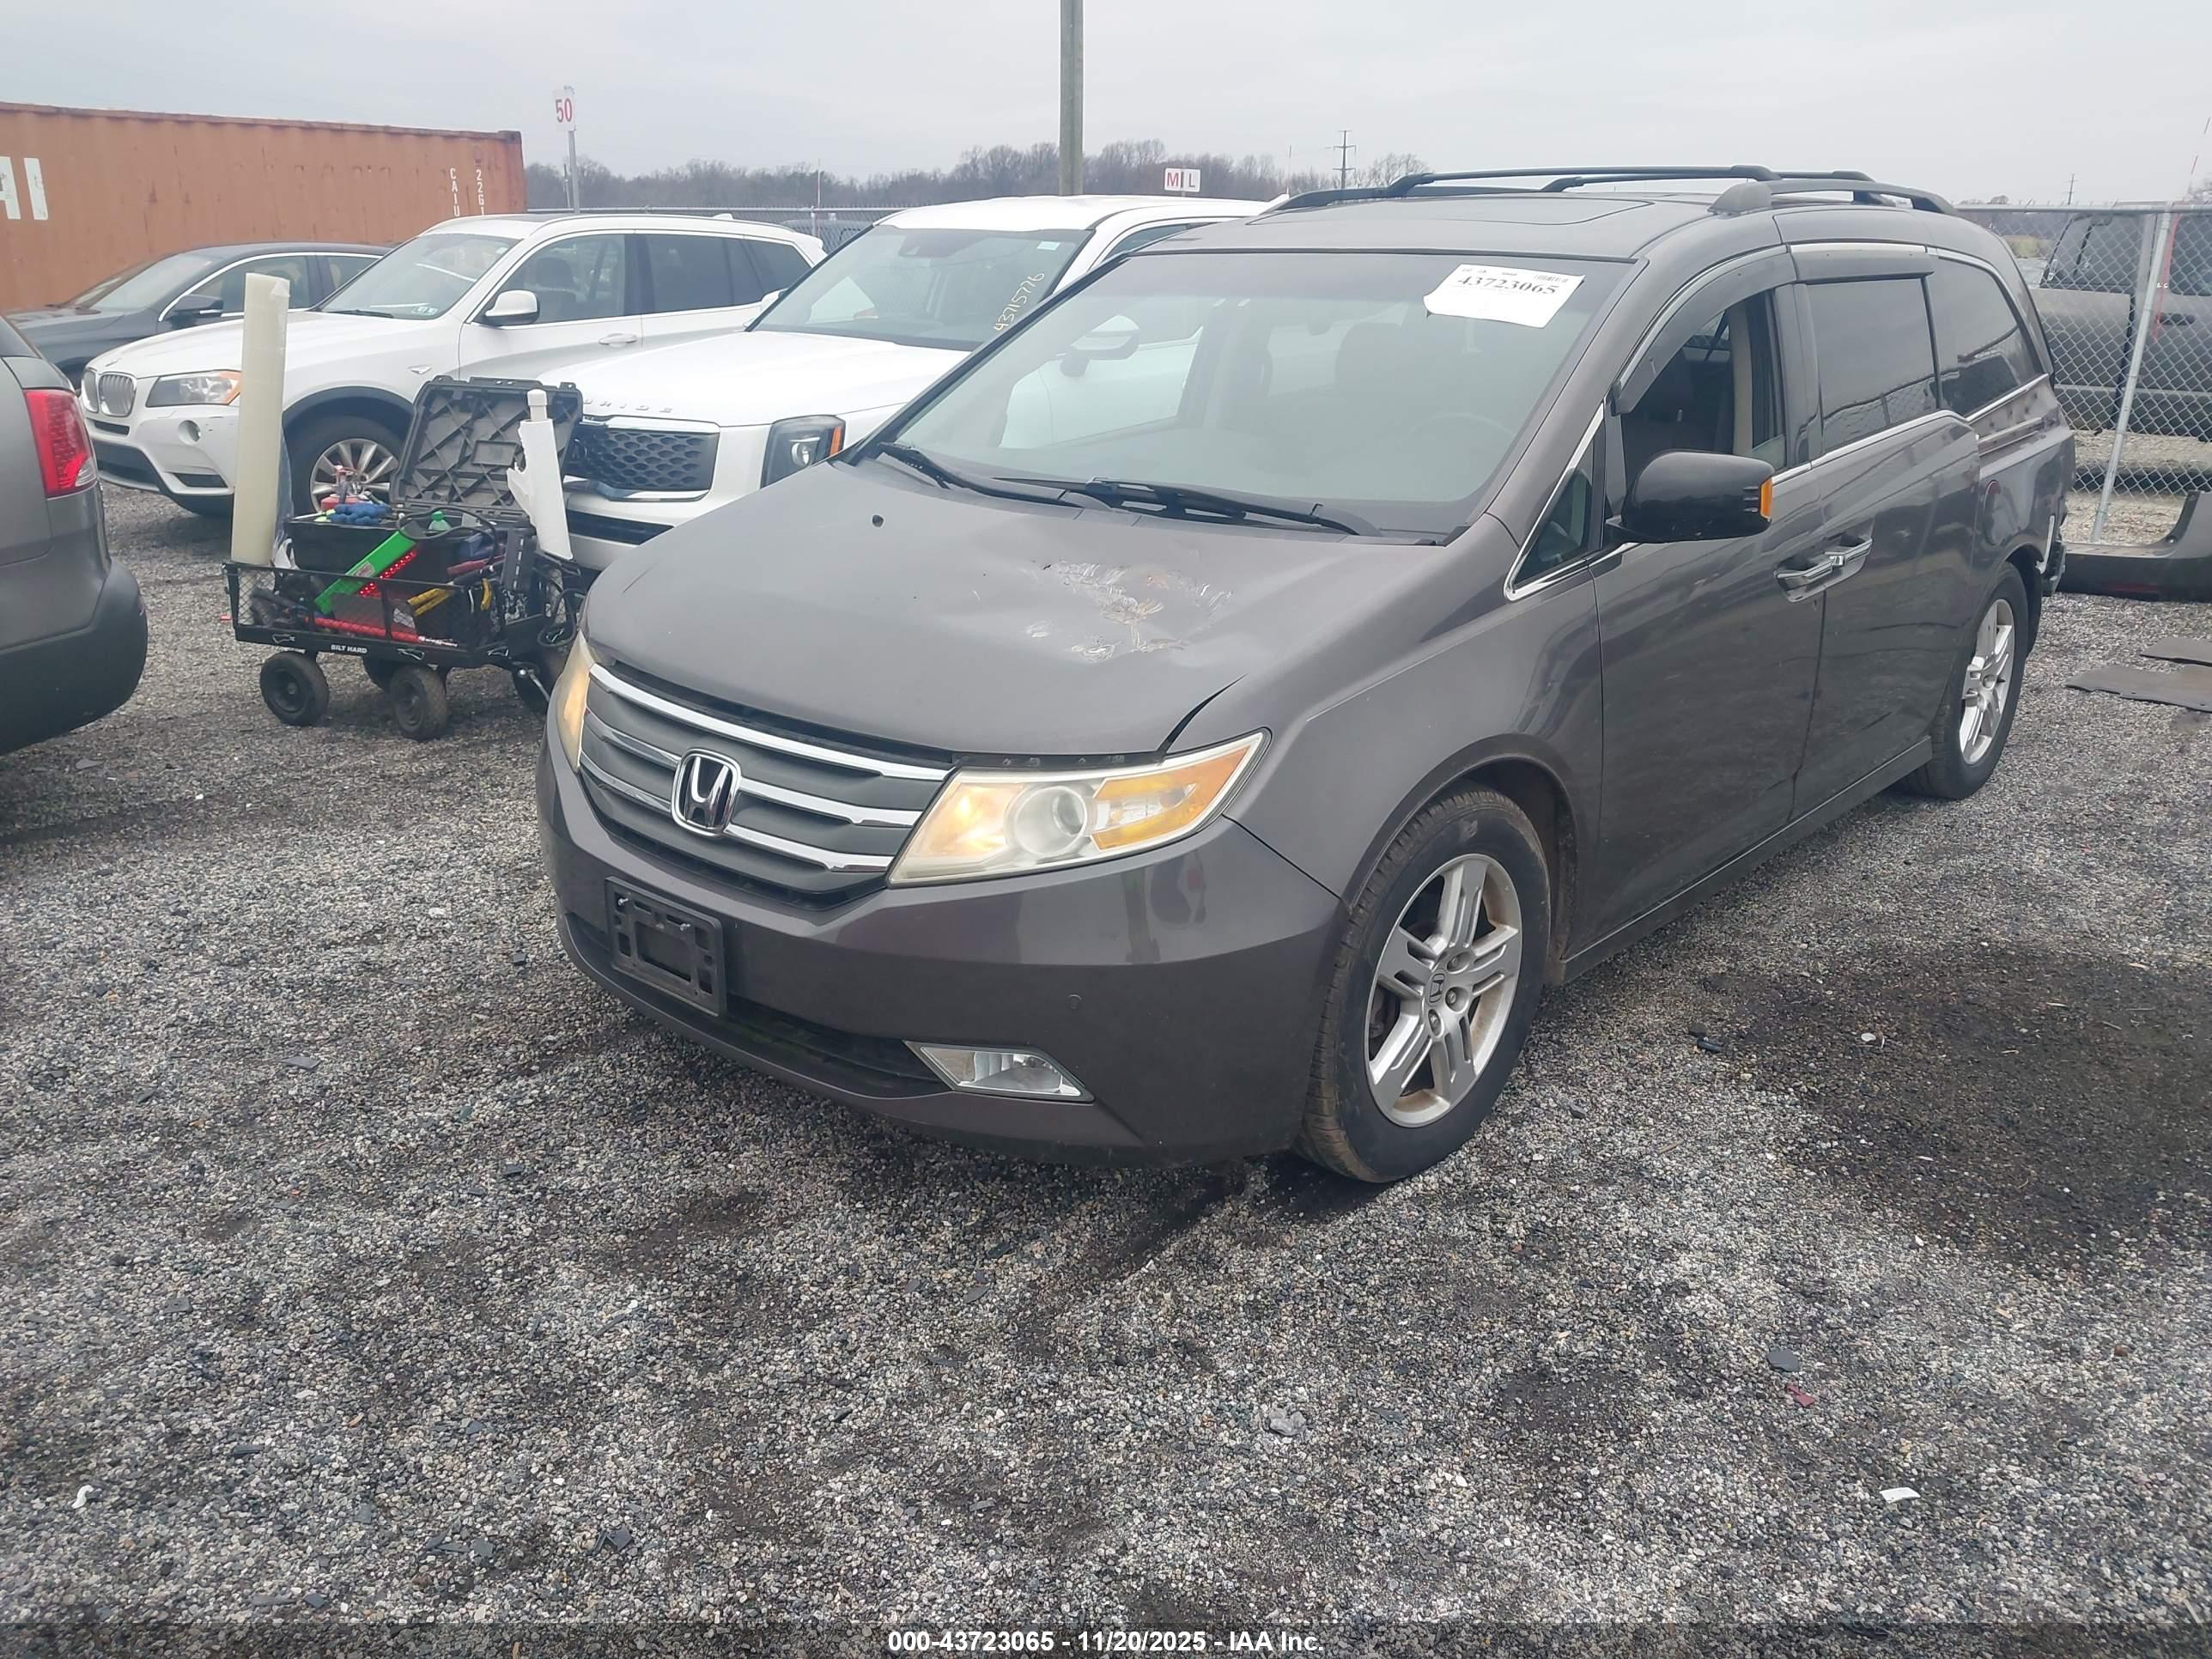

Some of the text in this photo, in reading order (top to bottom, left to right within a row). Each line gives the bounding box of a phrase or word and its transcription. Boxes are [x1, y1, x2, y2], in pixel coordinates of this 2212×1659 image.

[555, 97, 573, 123] 50
[449, 167, 460, 216] CAIU
[476, 169, 485, 216] 22G1
[1457, 275, 1560, 295] 43723065
